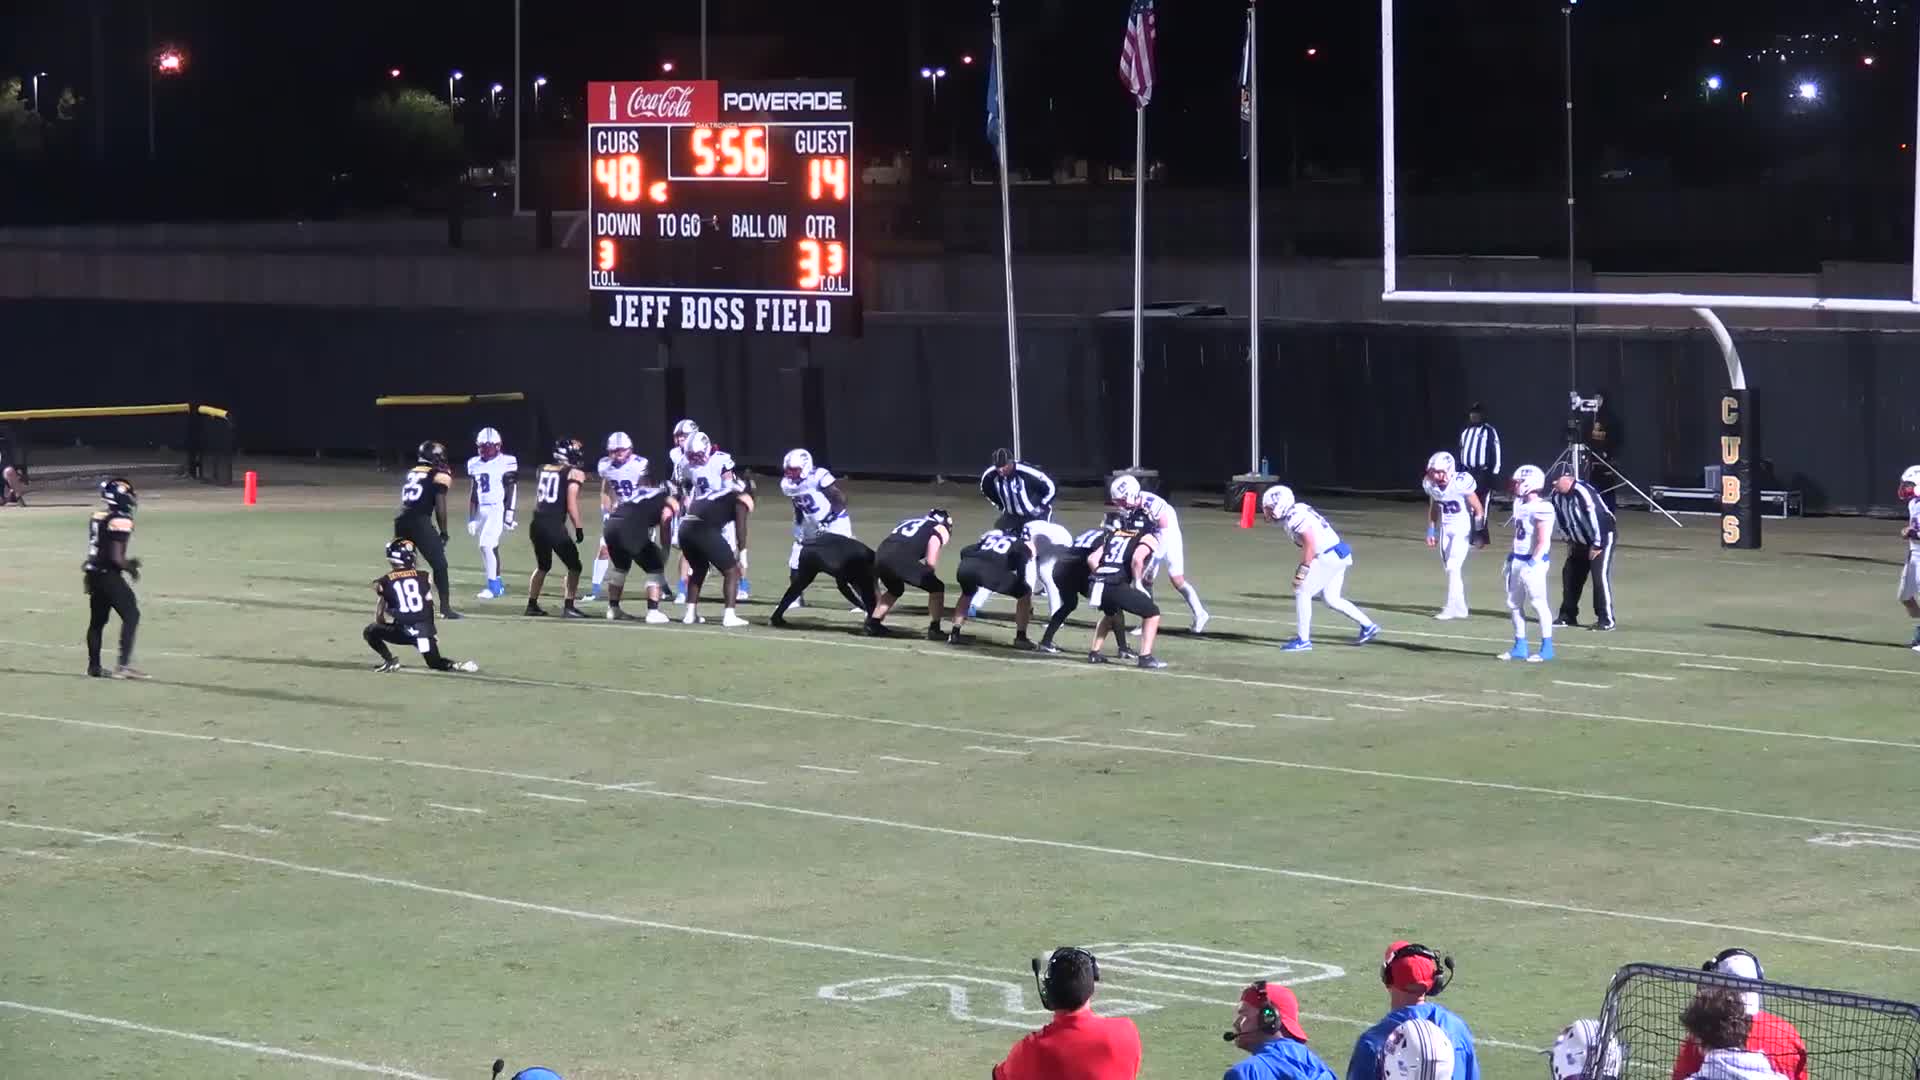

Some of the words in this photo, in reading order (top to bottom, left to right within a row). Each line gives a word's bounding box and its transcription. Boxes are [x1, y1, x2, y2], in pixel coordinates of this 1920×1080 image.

[627, 86, 695, 118] Coca-Cola
[723, 91, 843, 111] POWERADE
[597, 130, 639, 154] CUBS
[692, 129, 767, 175] 5:56
[795, 130, 847, 154] GUEST
[808, 157, 845, 200] 14
[598, 213, 641, 236] DOWN
[657, 214, 677, 237] TO
[681, 214, 700, 237] GO
[732, 215, 764, 238] BALL
[768, 215, 787, 238] ON
[806, 215, 836, 239] QTR
[599, 240, 615, 270] 3
[799, 240, 820, 288] 3
[827, 244, 844, 274] 3
[593, 271, 620, 286] T.O.L.
[819, 275, 848, 291] T.O.L.
[610, 295, 671, 328] JEFF
[681, 297, 745, 330] BOSS
[756, 299, 831, 333] FIELD
[1721, 396, 1741, 544] CUBS
[538, 472, 560, 504] 50
[980, 529, 1017, 554] 56
[1104, 536, 1131, 563] 31
[393, 578, 423, 613] 18
